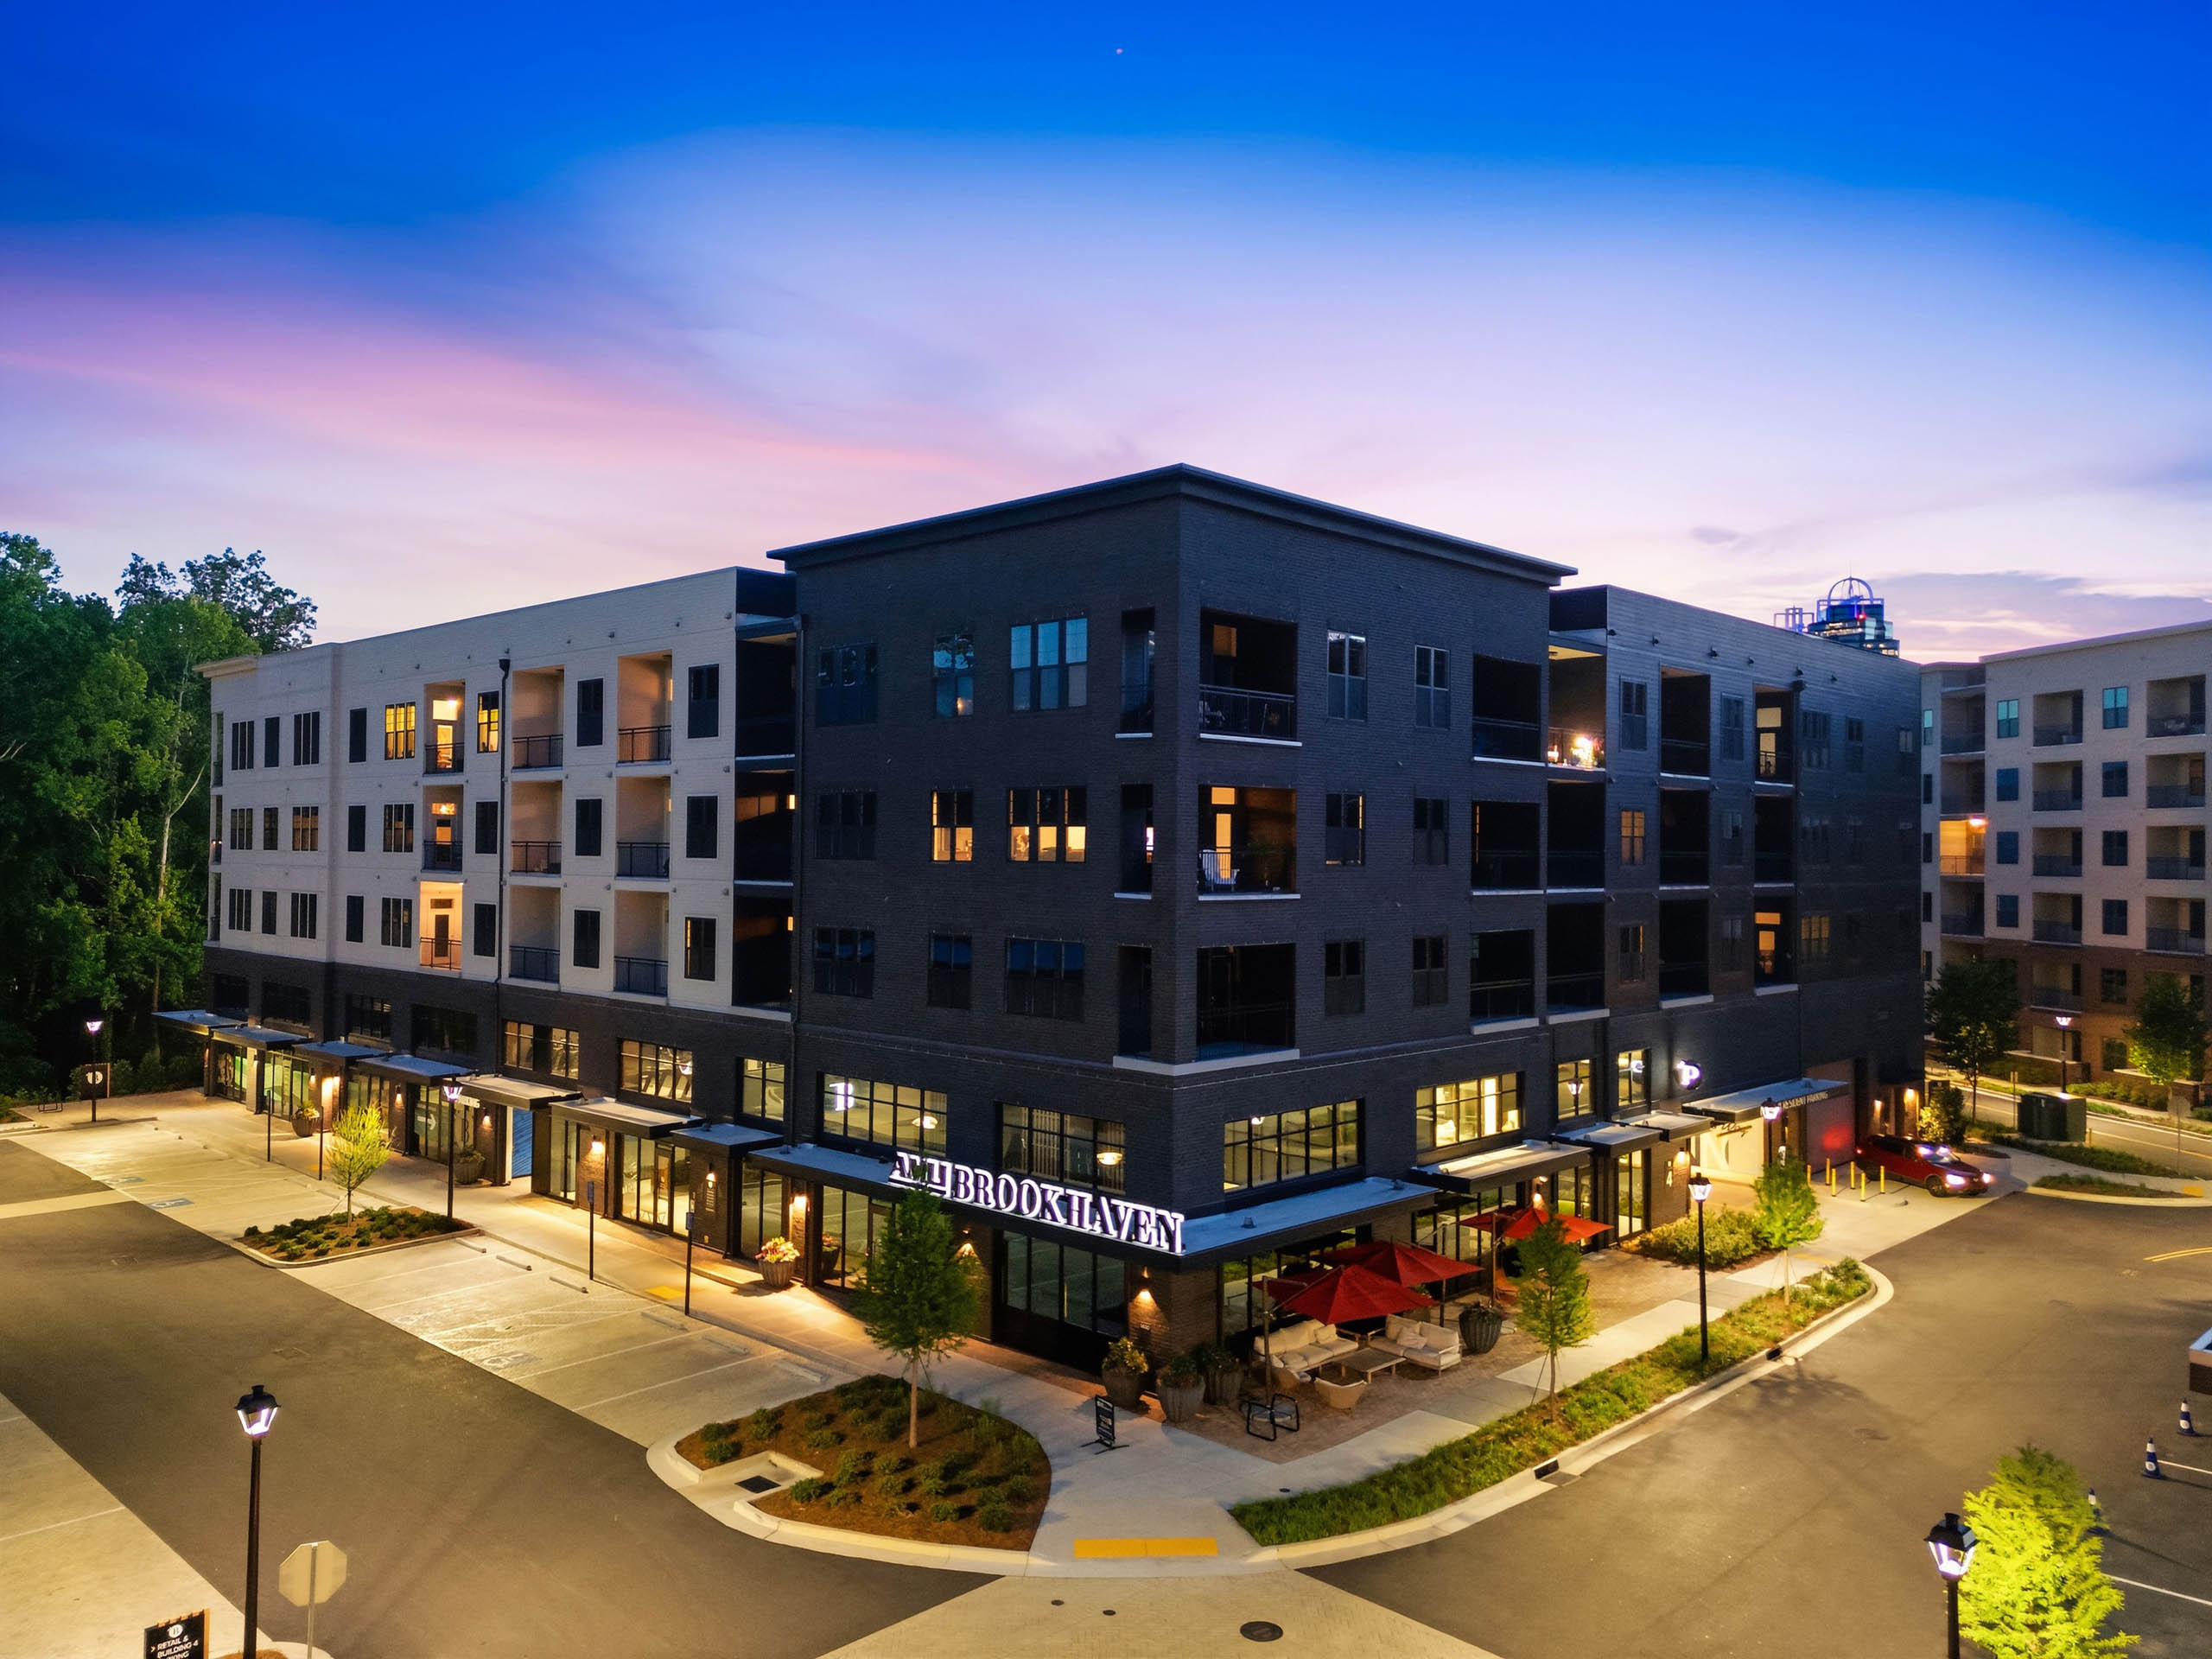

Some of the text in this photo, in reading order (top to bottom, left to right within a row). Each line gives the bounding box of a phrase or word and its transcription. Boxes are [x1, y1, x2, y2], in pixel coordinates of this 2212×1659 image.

[953, 1163, 1185, 1255] BROOKHAVEN
[157, 1637, 181, 1650] RETAIL
[157, 1642, 192, 1659] BUILDING
